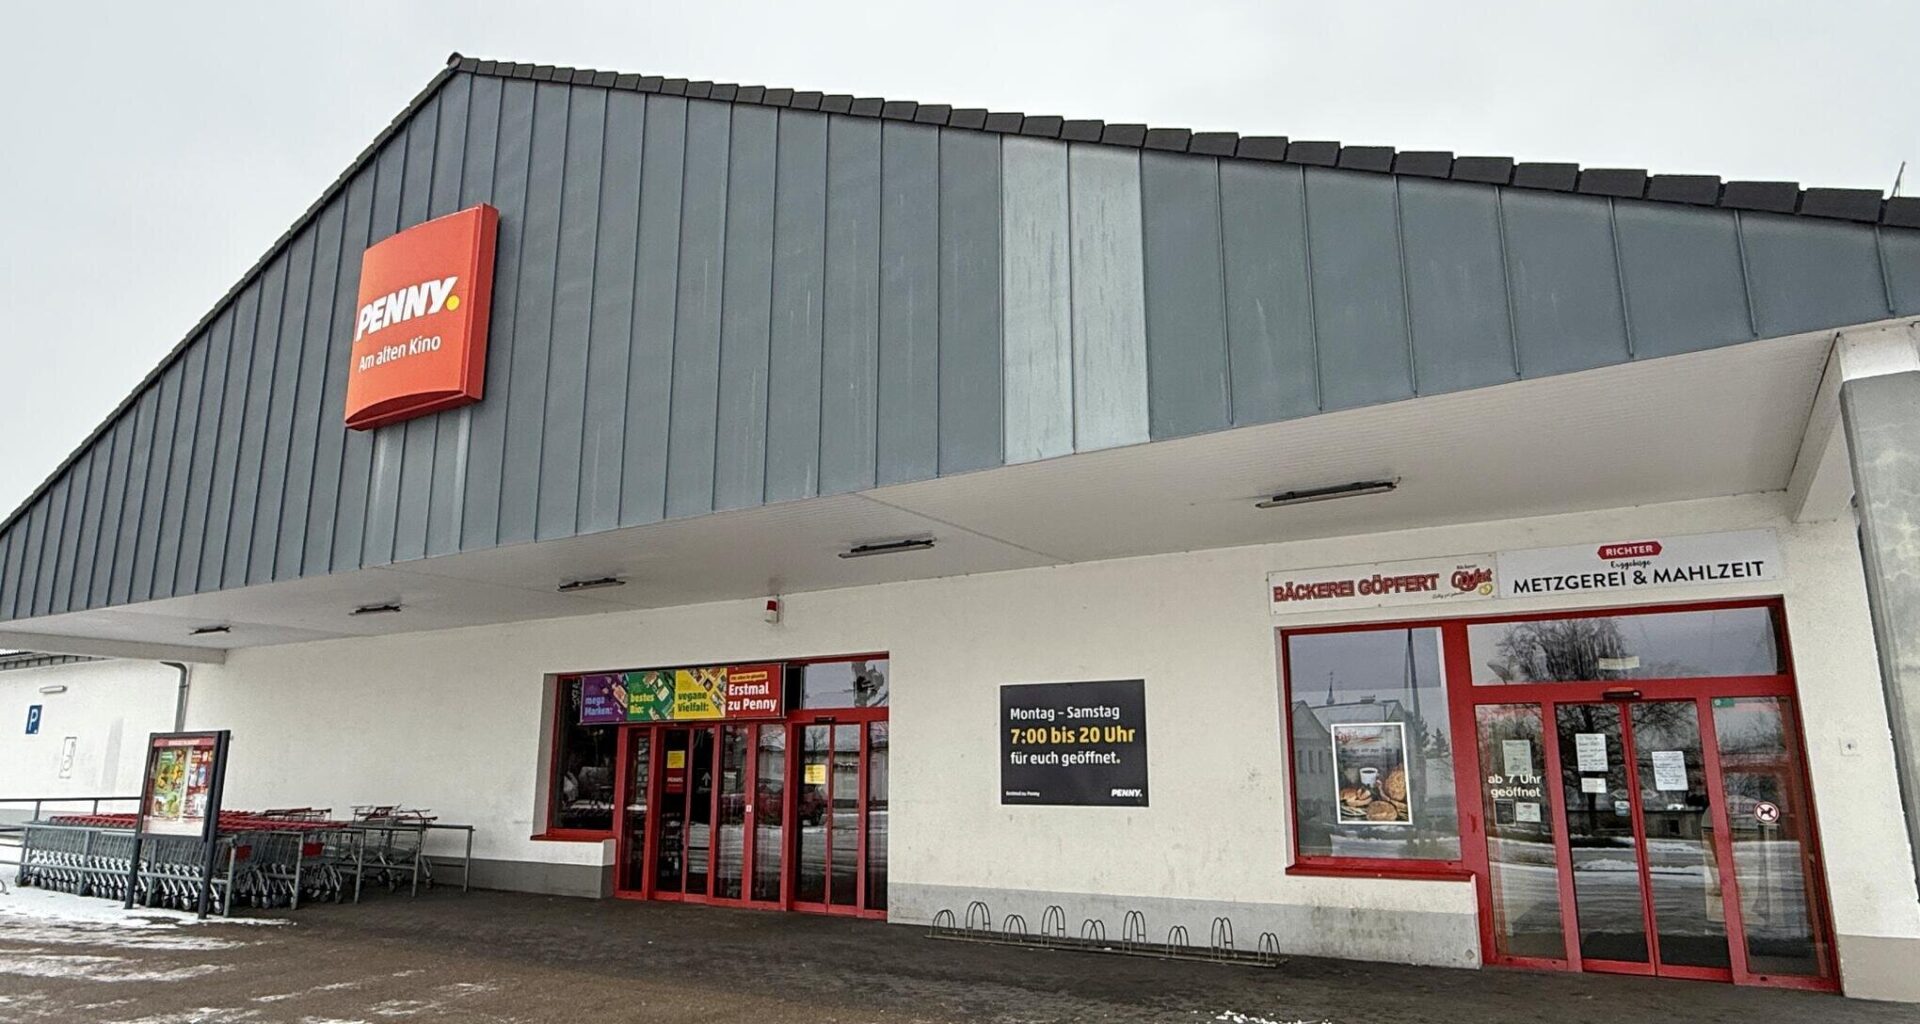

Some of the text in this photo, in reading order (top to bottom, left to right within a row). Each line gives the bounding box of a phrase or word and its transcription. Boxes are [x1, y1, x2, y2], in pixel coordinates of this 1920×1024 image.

[359, 335, 441, 372] Am alten Kino
[1605, 544, 1653, 556] RICHTER
[1513, 561, 1764, 594] METZGEREI & MAHLZEIT
[1273, 573, 1440, 602] BÄCKEREI GÖPFERT
[728, 682, 769, 696] Erstmal
[630, 693, 655, 702] bestes
[678, 692, 707, 702] vegane
[630, 705, 644, 714] Bio:
[678, 701, 709, 712] Vielfalt:
[728, 698, 777, 712] zu Penny
[28, 709, 38, 731] P
[1010, 707, 1055, 721] Montag
[1067, 705, 1120, 720] Samstag
[1010, 725, 1136, 745] 7:00 bis 20 Uhr
[1010, 751, 1121, 767] für euch geöffnet.
[1488, 773, 1541, 784] ab 7 Uhr
[1111, 788, 1143, 798] PENNY.
[1490, 786, 1541, 798] geöffnet
